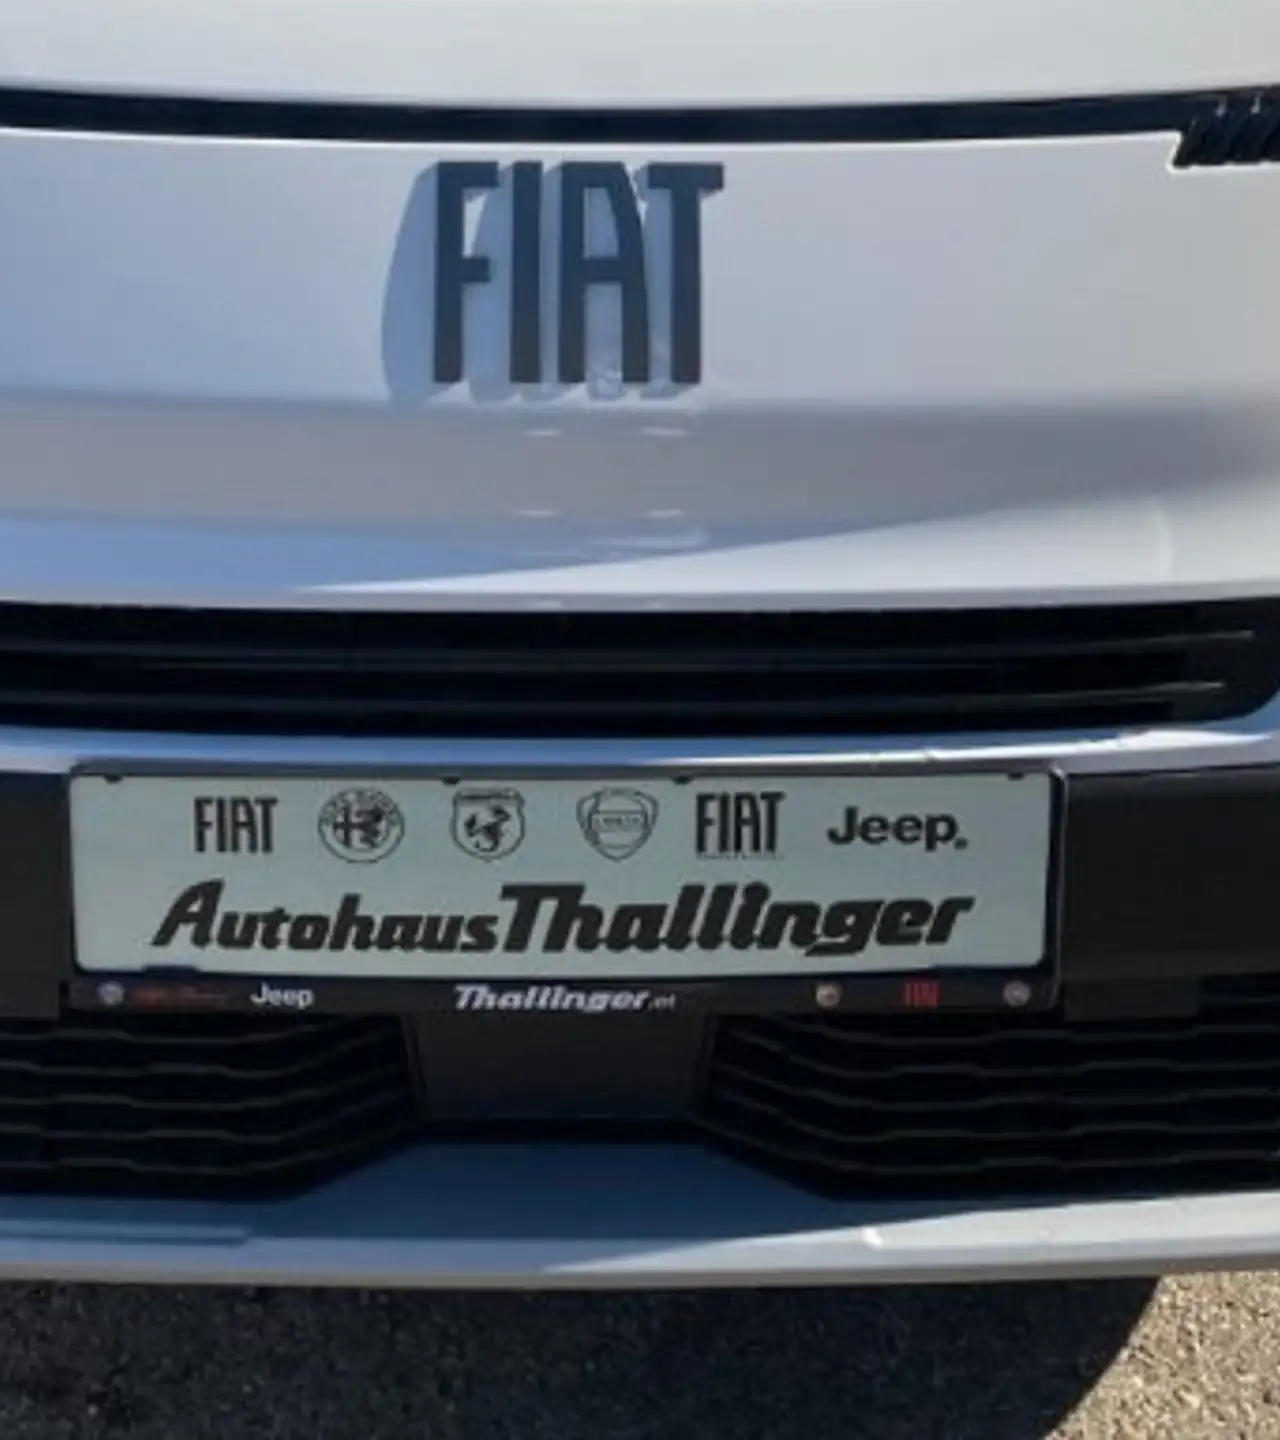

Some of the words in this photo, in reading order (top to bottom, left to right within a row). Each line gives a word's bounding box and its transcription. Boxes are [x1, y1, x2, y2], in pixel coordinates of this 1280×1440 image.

[433, 160, 725, 384] FIAT
[193, 796, 279, 854] FIAT
[695, 791, 786, 853] FIAT
[250, 982, 315, 1009] Jeep
